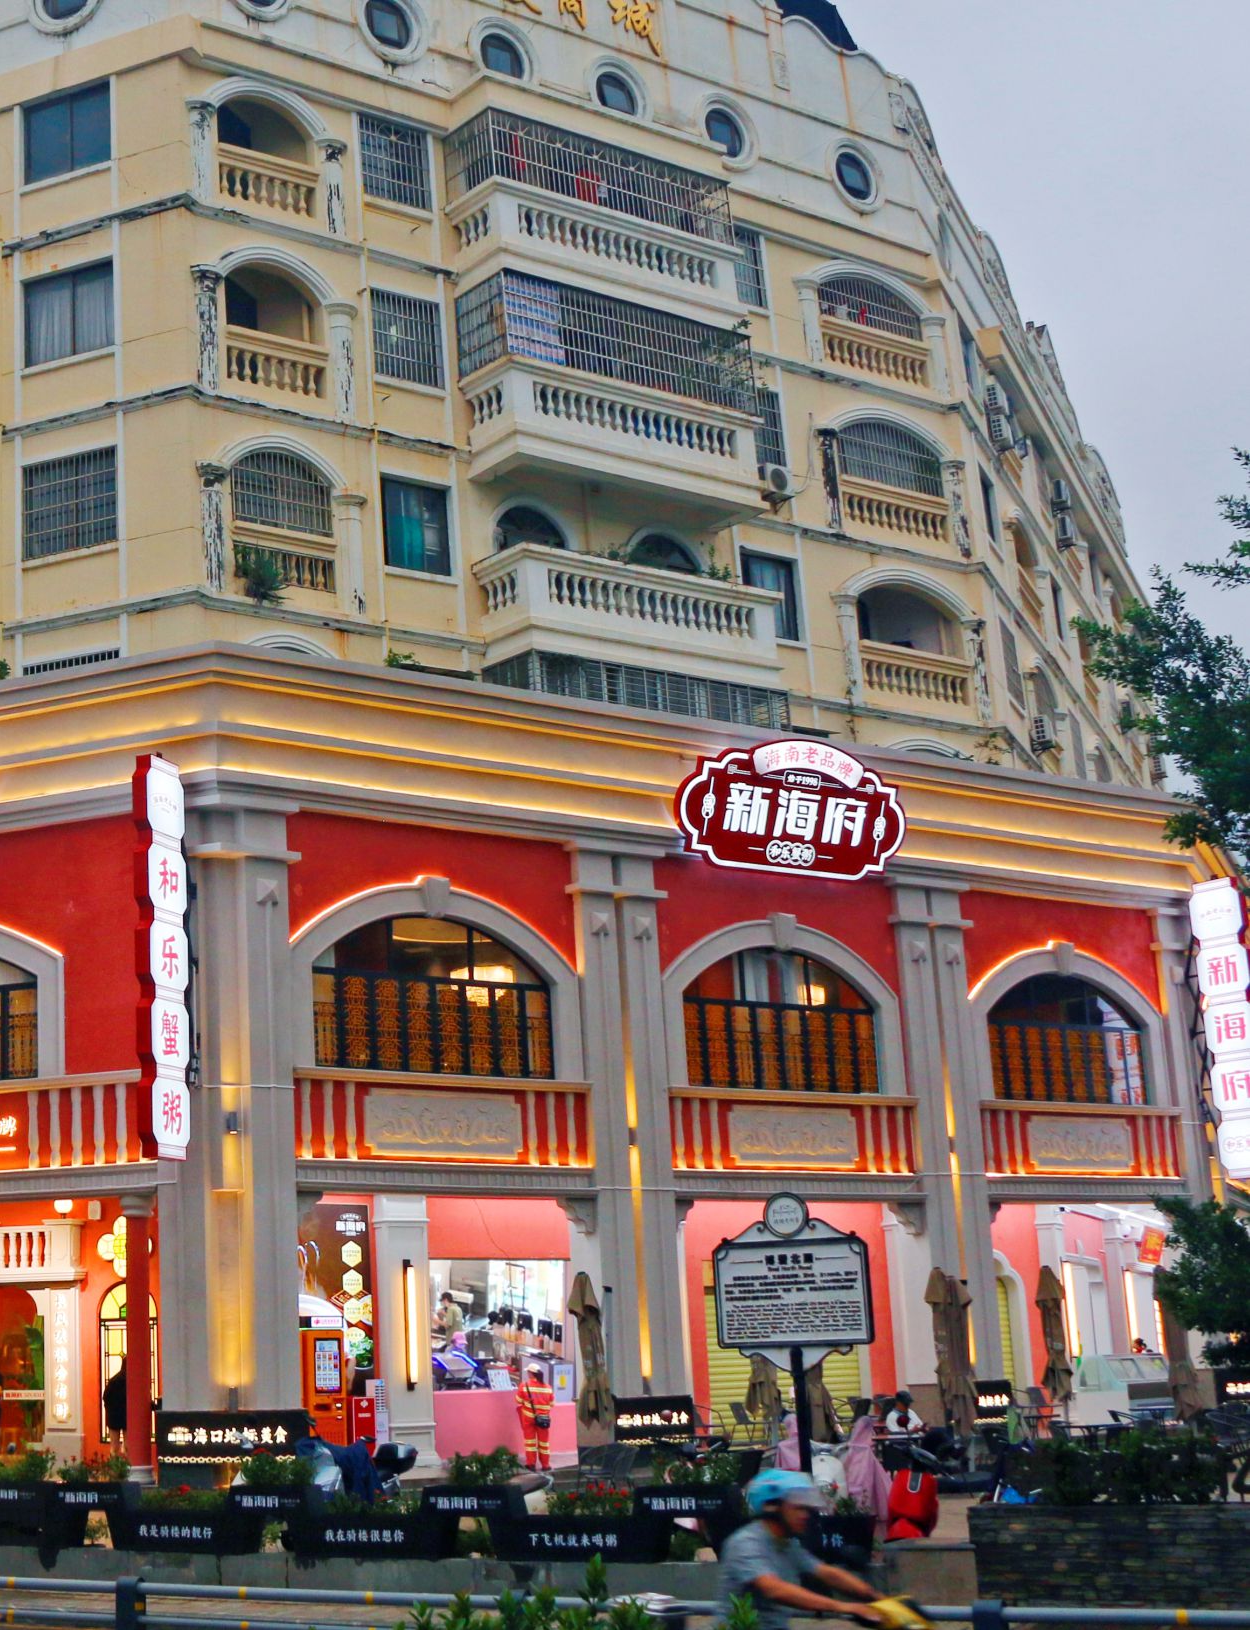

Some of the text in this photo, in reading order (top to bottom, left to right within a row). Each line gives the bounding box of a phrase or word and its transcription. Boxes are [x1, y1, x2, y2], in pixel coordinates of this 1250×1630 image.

[765, 744, 855, 780] 海南老品牌
[722, 782, 868, 848] 新海府
[158, 857, 182, 1135] 和乐蟹粥
[1206, 954, 1250, 1101] 新海府
[528, 1533, 618, 1548] 下飞机就来喝粥
